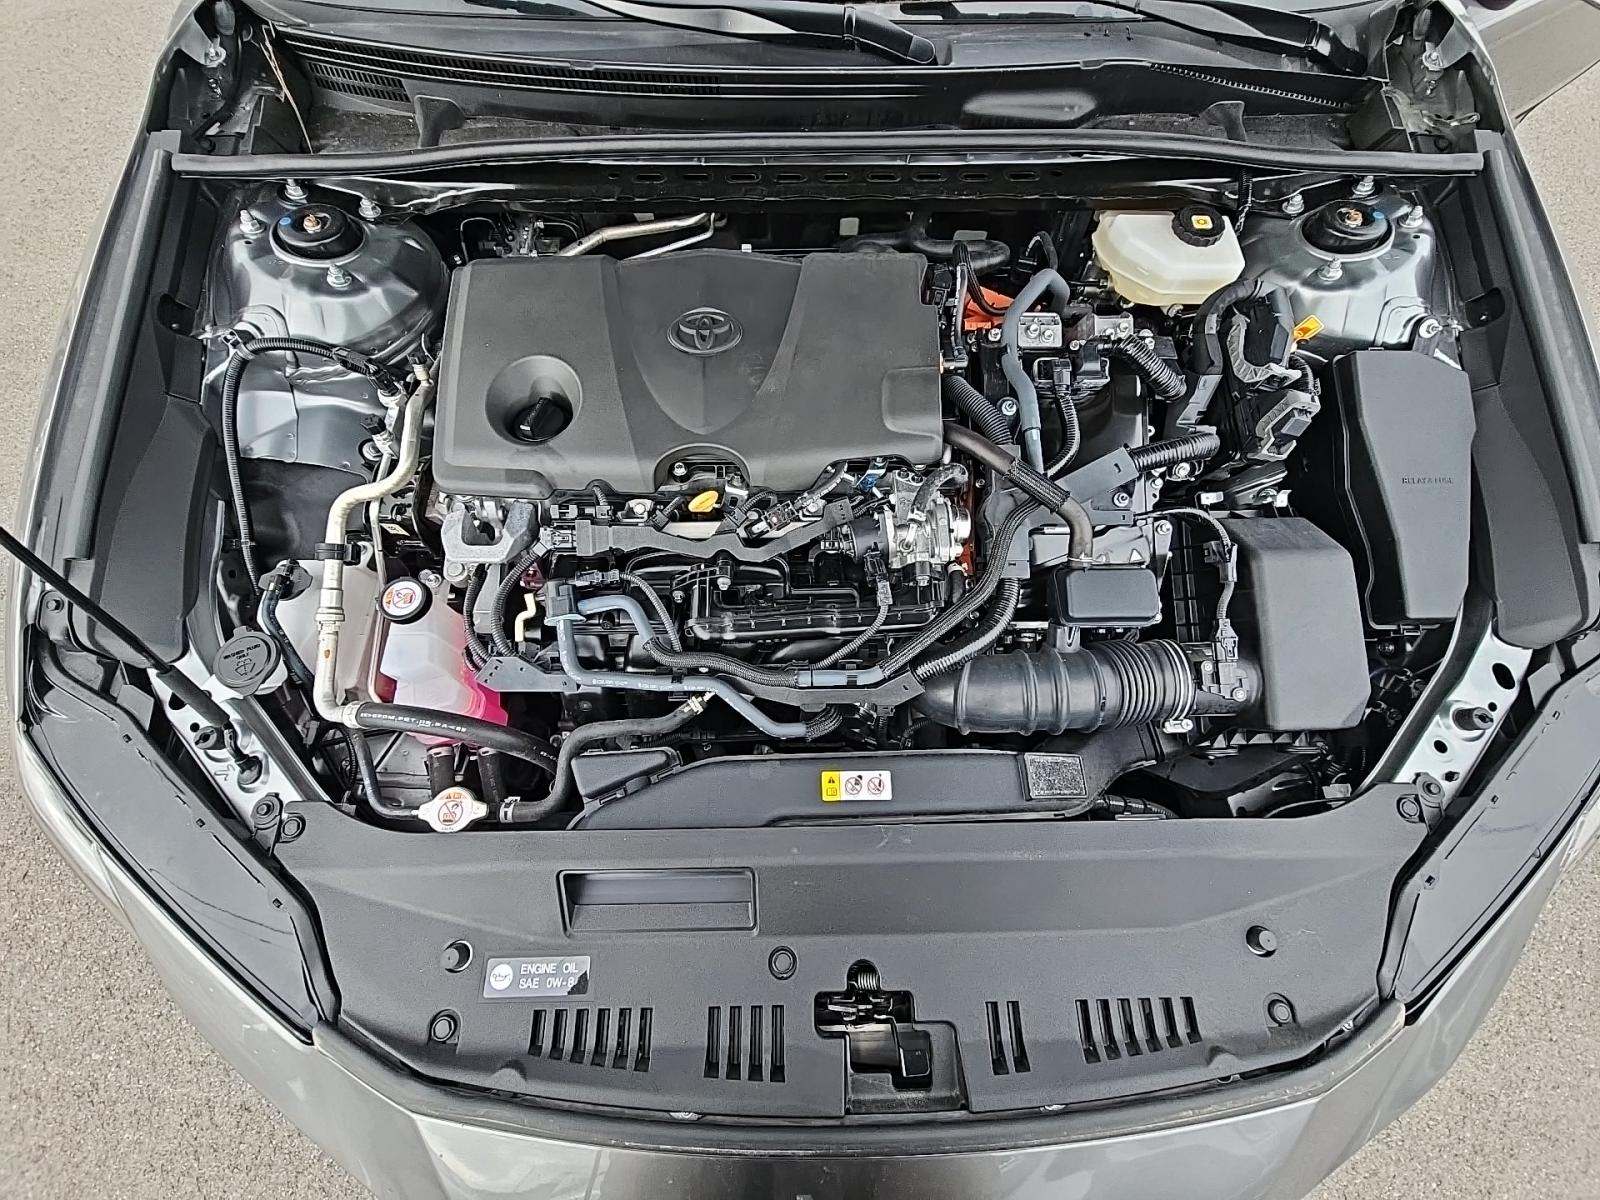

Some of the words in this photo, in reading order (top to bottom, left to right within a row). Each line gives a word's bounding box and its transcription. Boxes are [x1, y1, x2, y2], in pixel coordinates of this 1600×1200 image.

[520, 963, 557, 975] ENGINE
[562, 962, 579, 974] OIL
[518, 977, 540, 989] SAE
